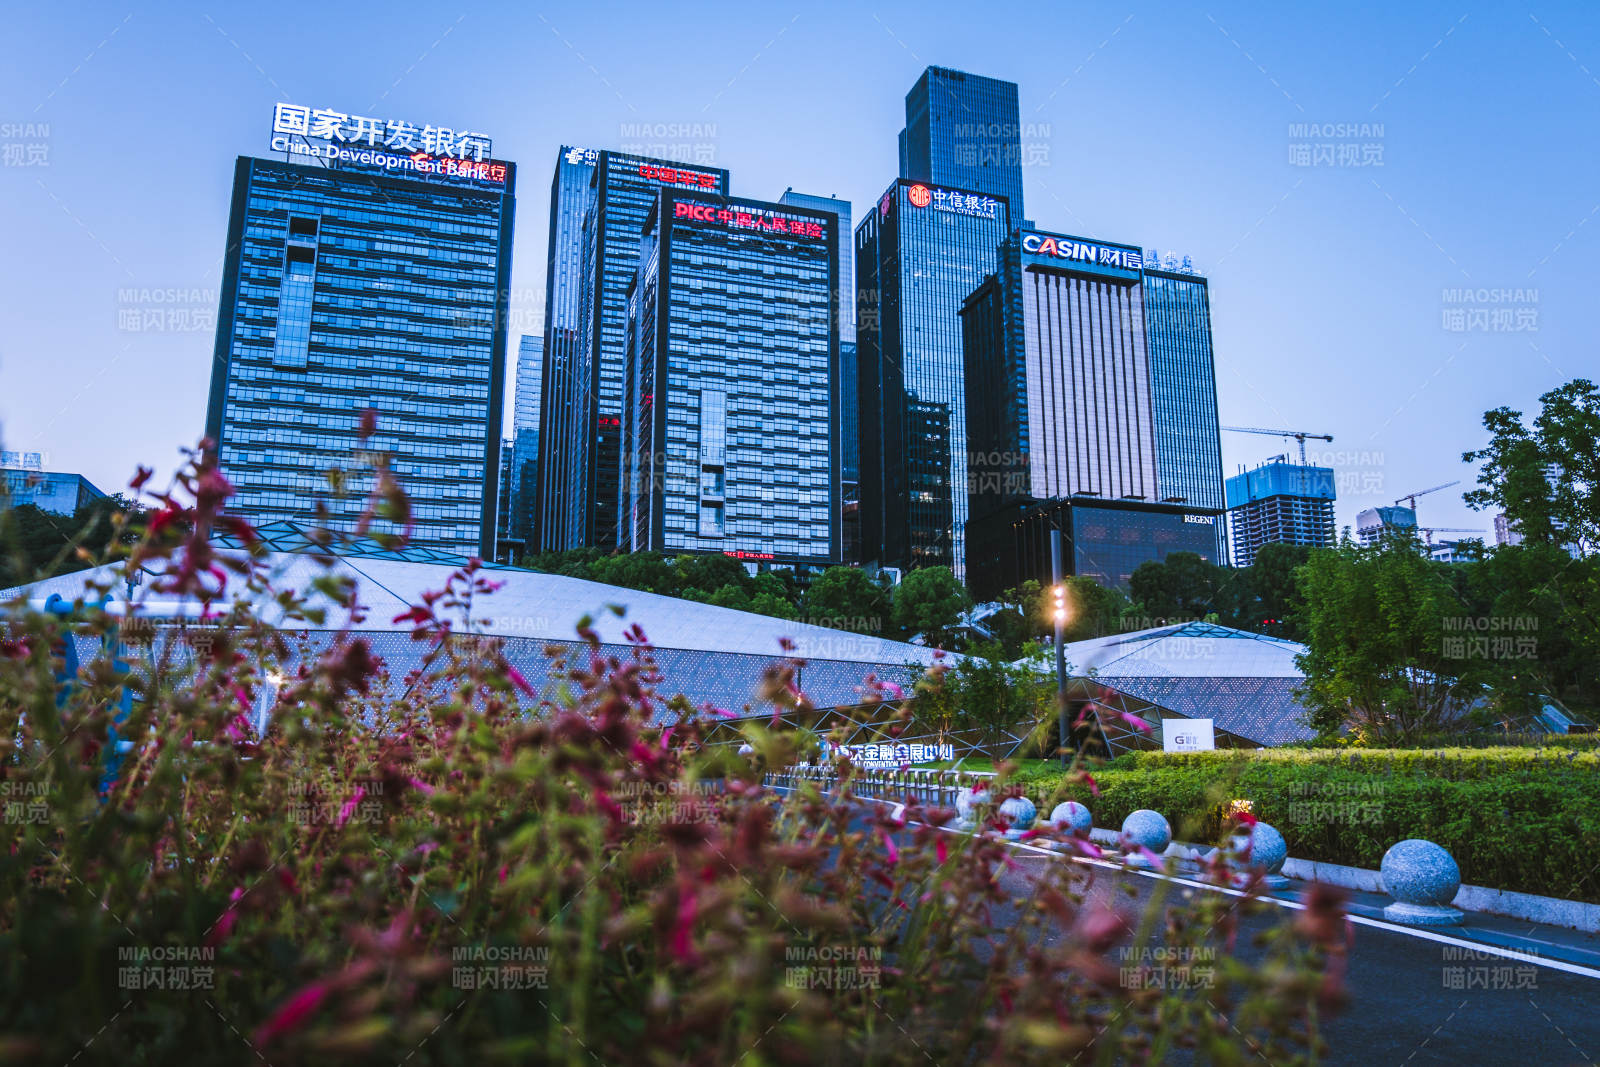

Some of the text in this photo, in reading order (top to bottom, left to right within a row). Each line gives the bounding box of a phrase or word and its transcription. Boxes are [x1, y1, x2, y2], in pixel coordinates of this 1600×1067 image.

[274, 102, 490, 162] 国家开发银行
[271, 136, 488, 180] China Development Bank
[639, 165, 716, 189] 中国平安
[933, 188, 998, 214] 中信银行
[933, 204, 996, 219] CHINA CITIC BANK
[675, 202, 823, 238] PICC 中国人民保险
[1023, 235, 1097, 262] CASIN
[1100, 247, 1142, 269] 财信
[1184, 514, 1214, 525] REGENT
